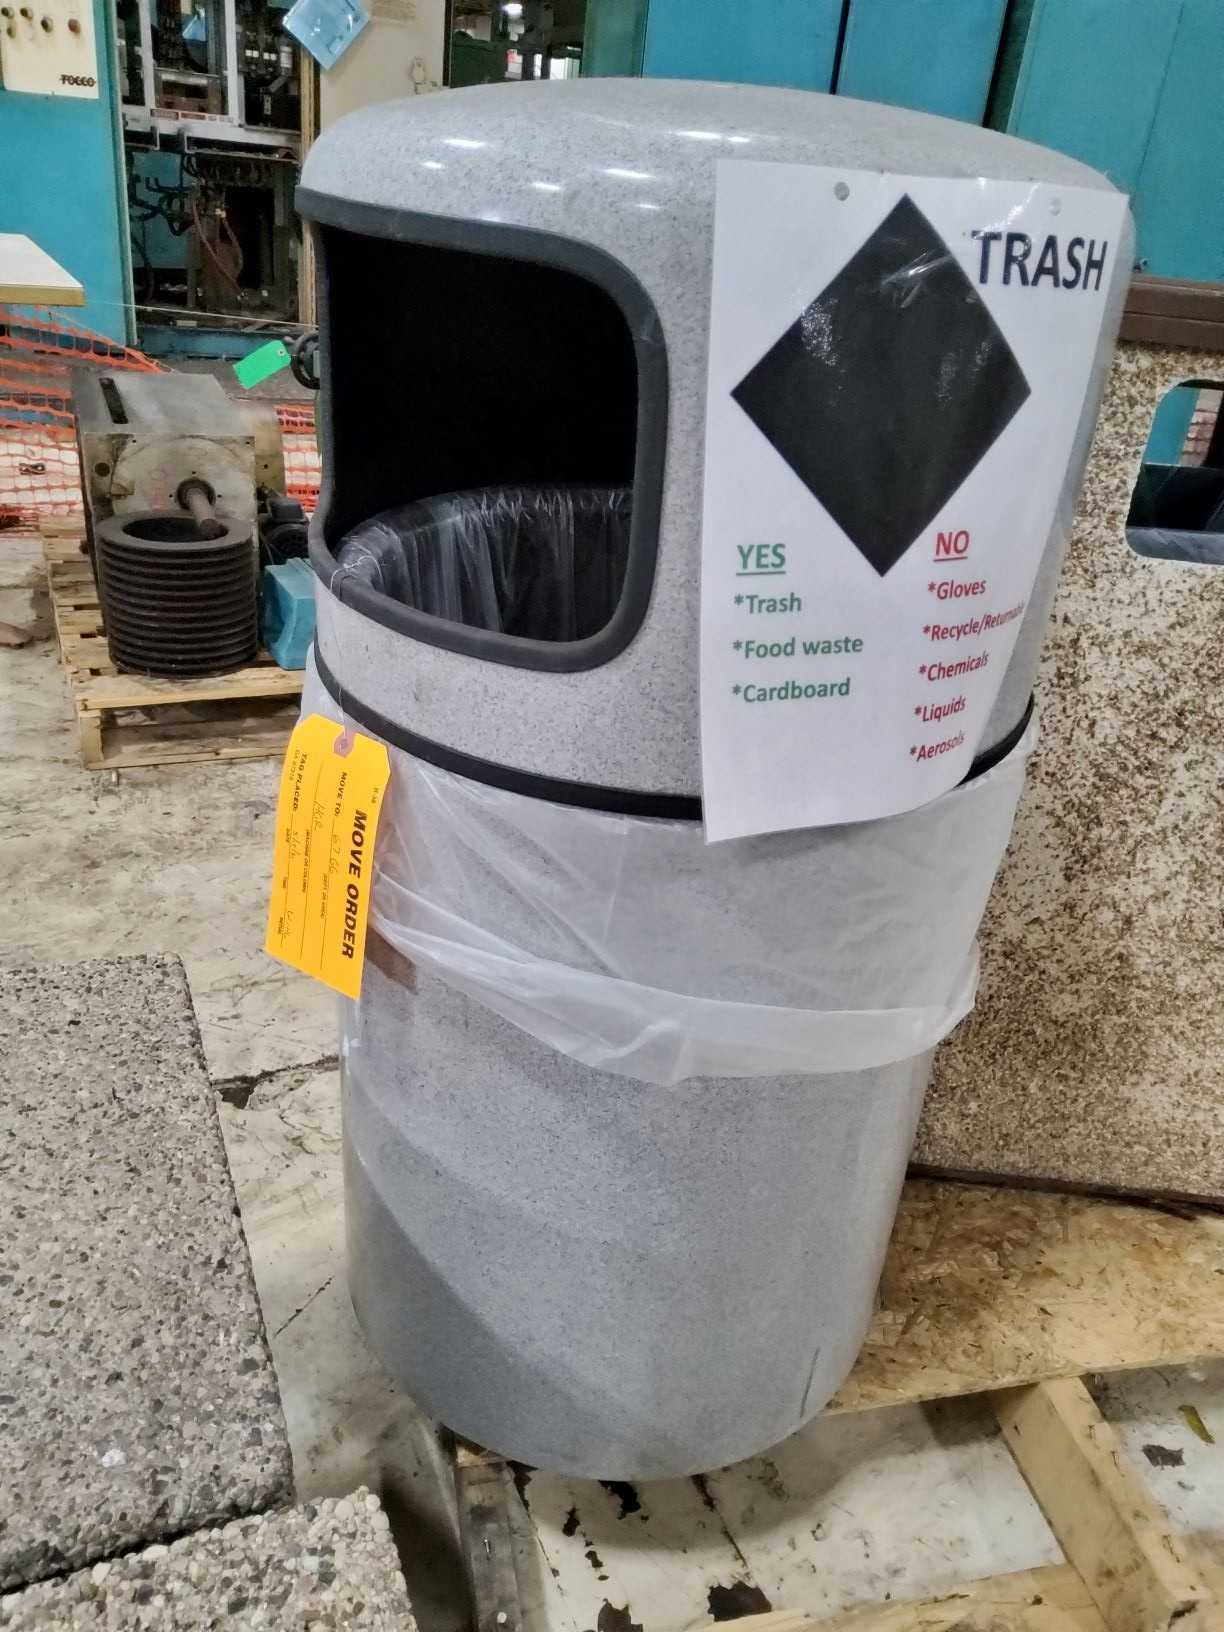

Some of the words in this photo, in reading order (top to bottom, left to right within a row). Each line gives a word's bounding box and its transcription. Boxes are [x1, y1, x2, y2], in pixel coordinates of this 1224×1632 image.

[971, 230, 1108, 291] TRASH
[736, 543, 786, 572] YES
[934, 530, 970, 558] NO
[802, 636, 864, 656] waste
[298, 753, 308, 772] TAG
[337, 771, 348, 800] MOVE
[349, 809, 368, 879] MOVE
[342, 884, 360, 959] ORDER
